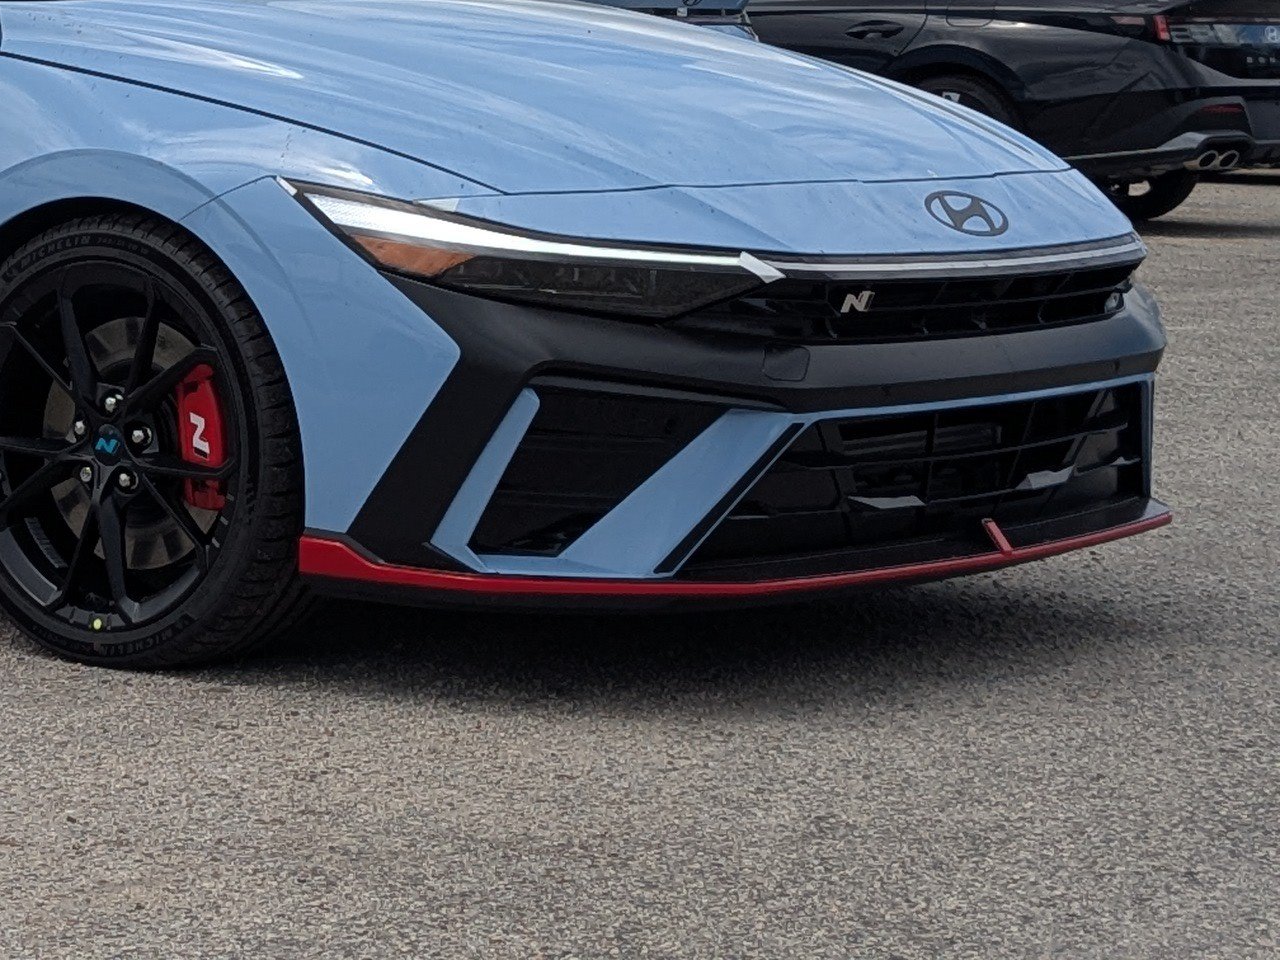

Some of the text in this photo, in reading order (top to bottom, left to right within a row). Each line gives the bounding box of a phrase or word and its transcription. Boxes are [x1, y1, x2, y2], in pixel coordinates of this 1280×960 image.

[20, 235, 92, 269] MICHELIN
[840, 290, 875, 313] N
[95, 437, 120, 456] N
[189, 412, 210, 460] N
